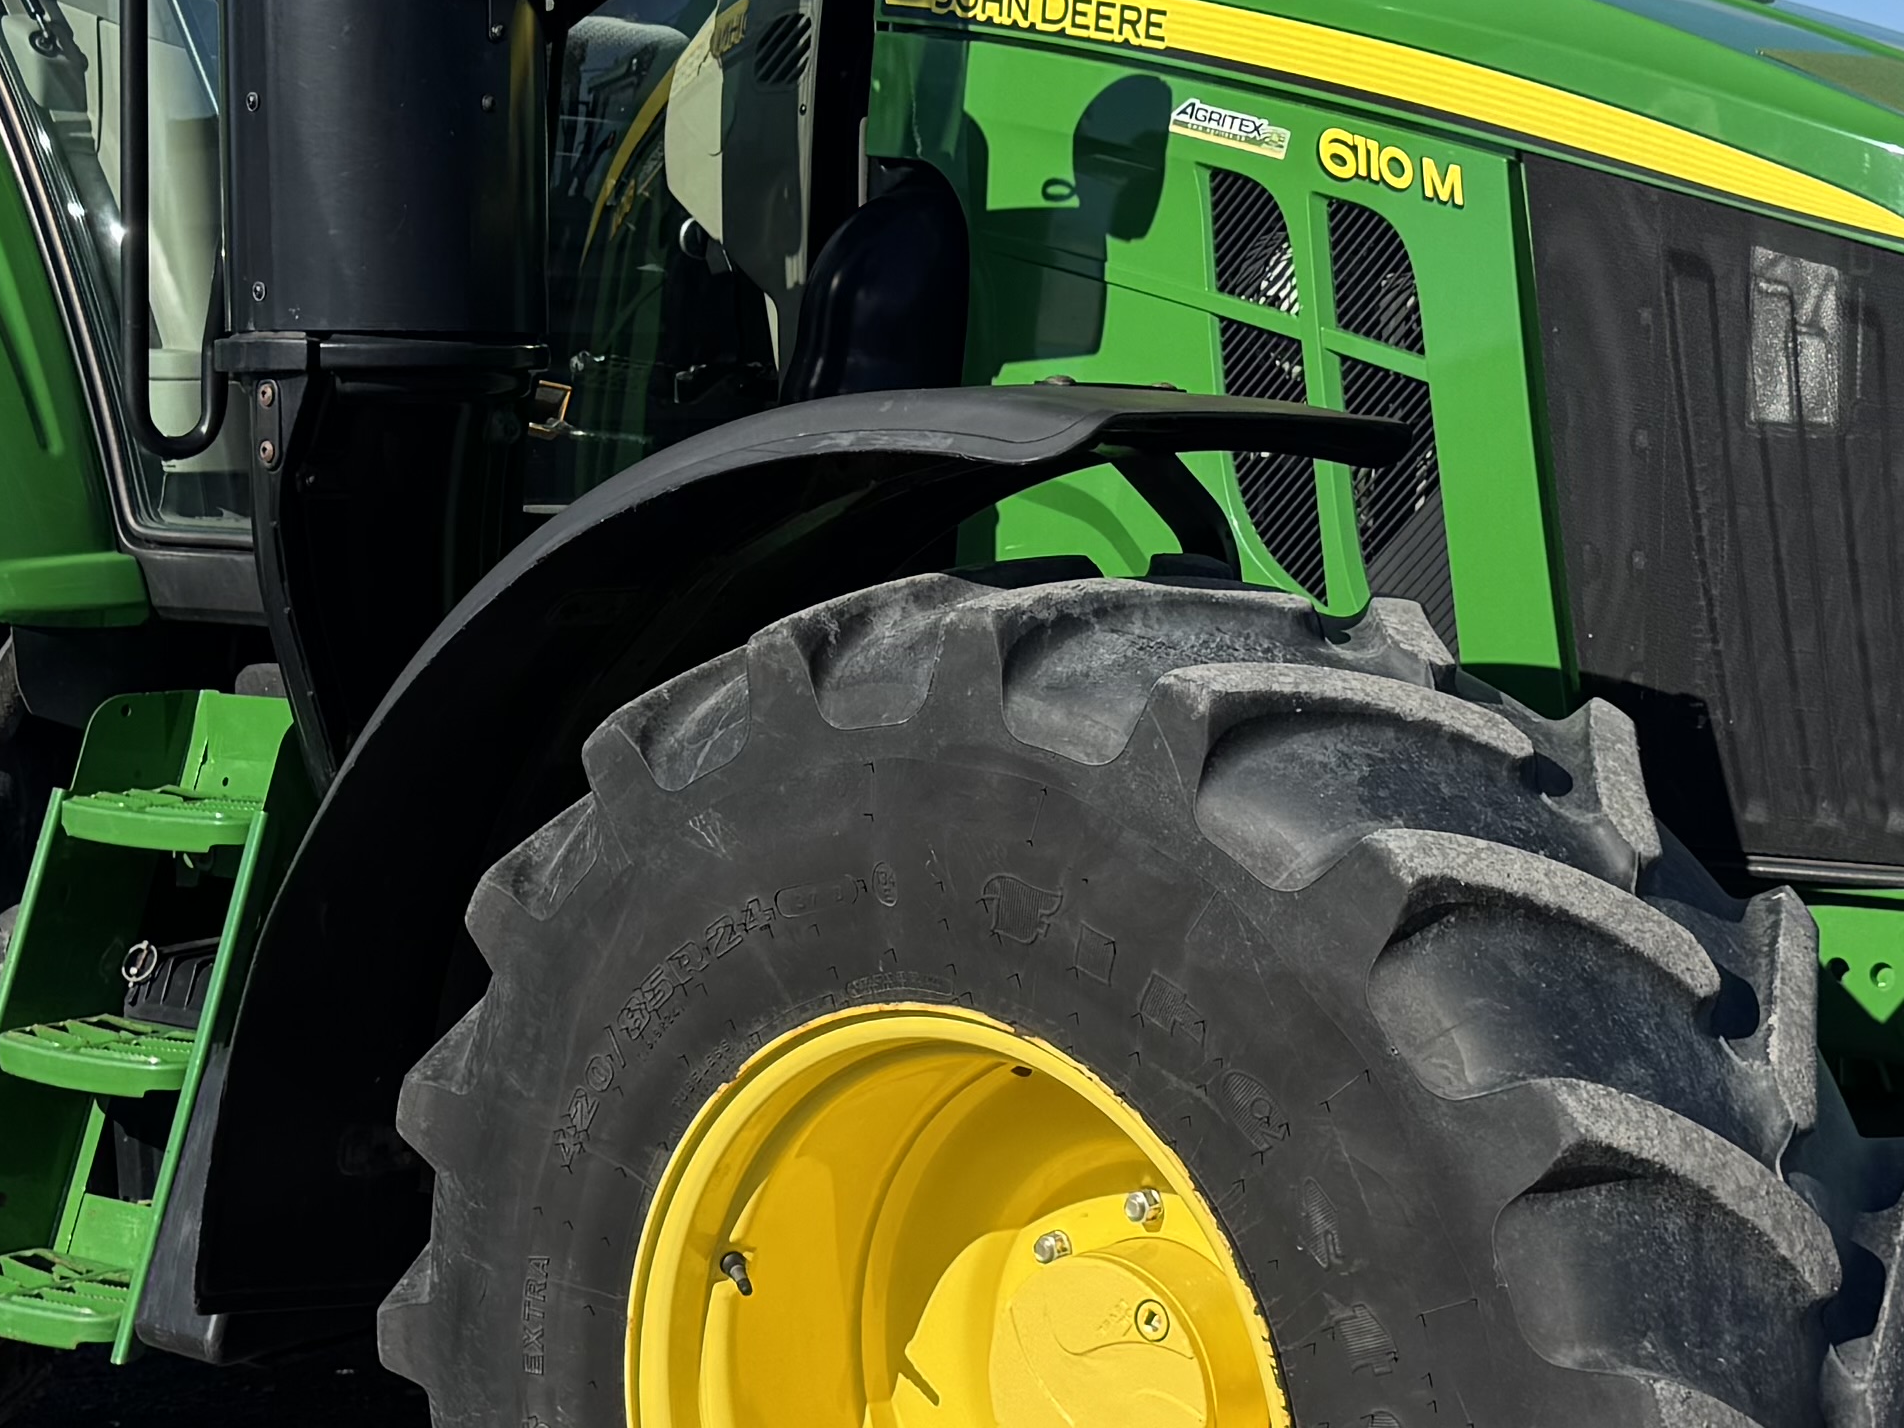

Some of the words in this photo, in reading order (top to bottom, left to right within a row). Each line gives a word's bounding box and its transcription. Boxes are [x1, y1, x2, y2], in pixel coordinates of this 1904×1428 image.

[1176, 101, 1264, 137] AGRITEX
[1318, 127, 1414, 190] 6110
[1421, 156, 1465, 207] M
[522, 1256, 550, 1376] EXTRA
[554, 897, 777, 1166] 420/85R24
